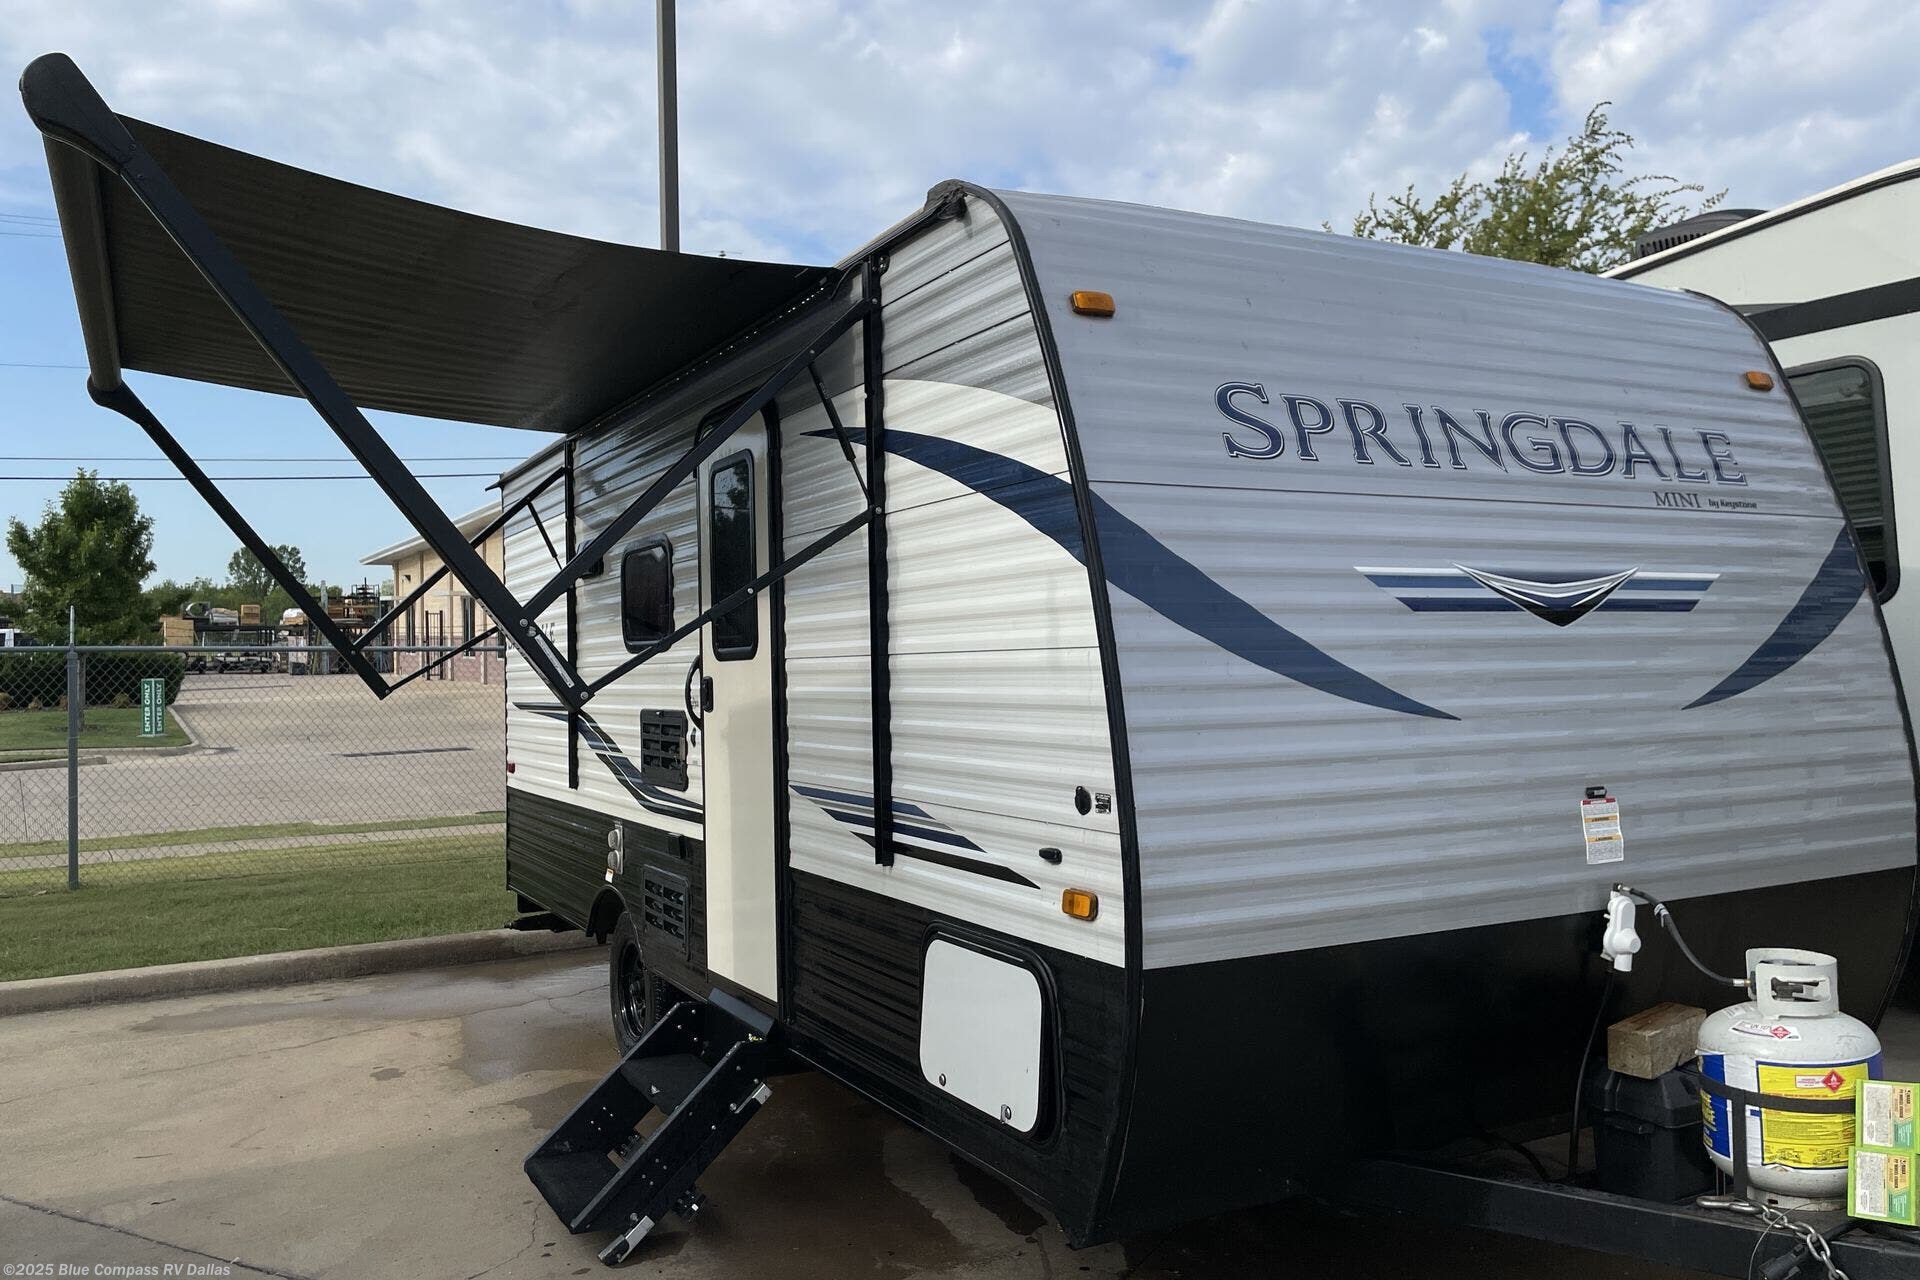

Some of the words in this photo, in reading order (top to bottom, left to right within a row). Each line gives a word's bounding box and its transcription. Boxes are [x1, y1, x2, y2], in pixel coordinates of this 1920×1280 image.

[1214, 381, 1747, 486] SPRINGDALE
[1653, 490, 1702, 509] MINI
[1708, 498, 1720, 509] by
[1720, 499, 1758, 510] Keystone
